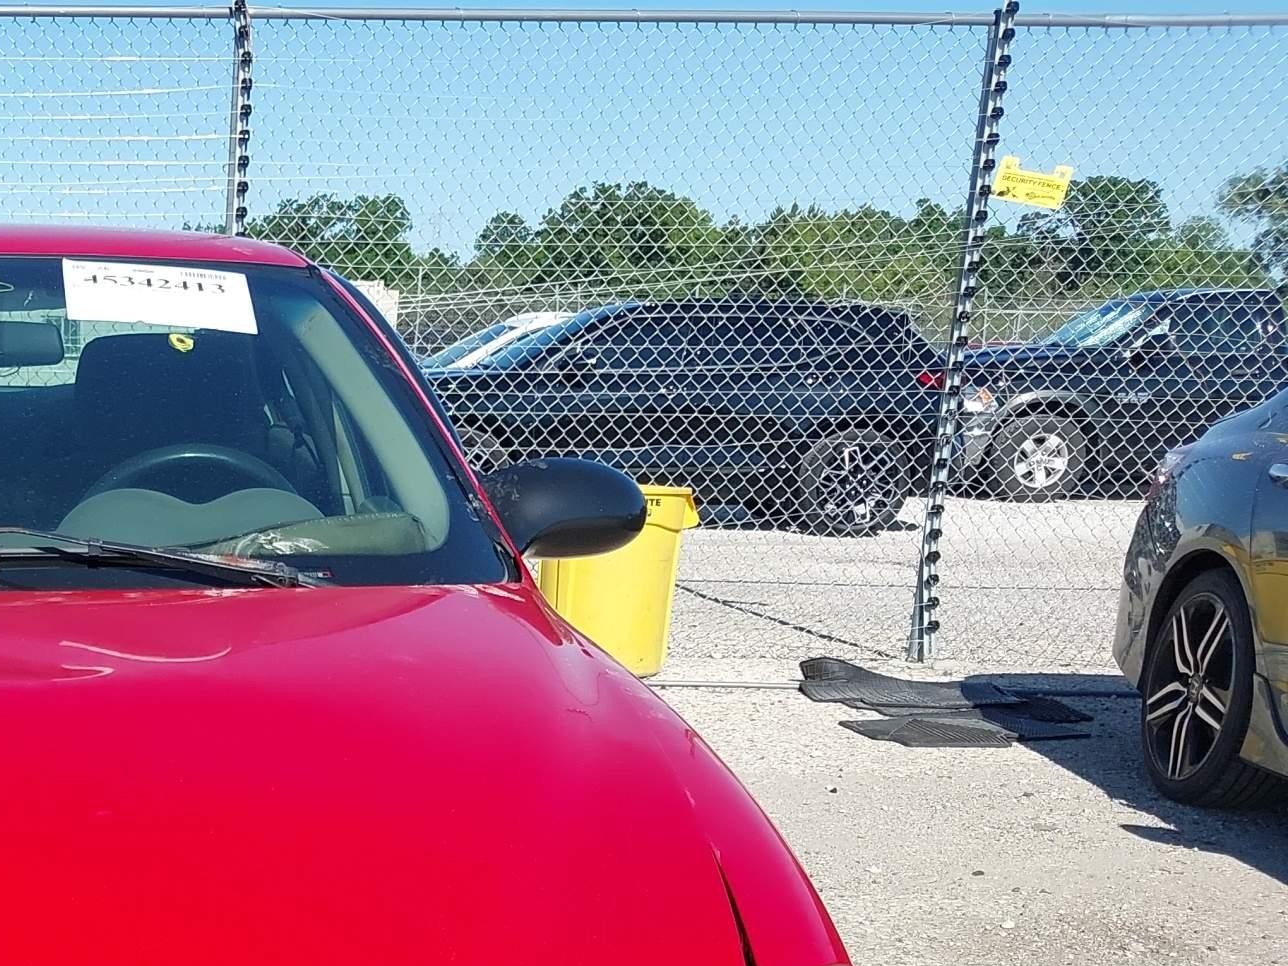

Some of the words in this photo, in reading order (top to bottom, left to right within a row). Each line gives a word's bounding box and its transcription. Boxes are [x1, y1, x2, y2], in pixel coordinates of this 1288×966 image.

[1002, 175, 1037, 186] SECURITY
[1038, 181, 1061, 191] FENCE
[83, 273, 226, 294] 45342413
